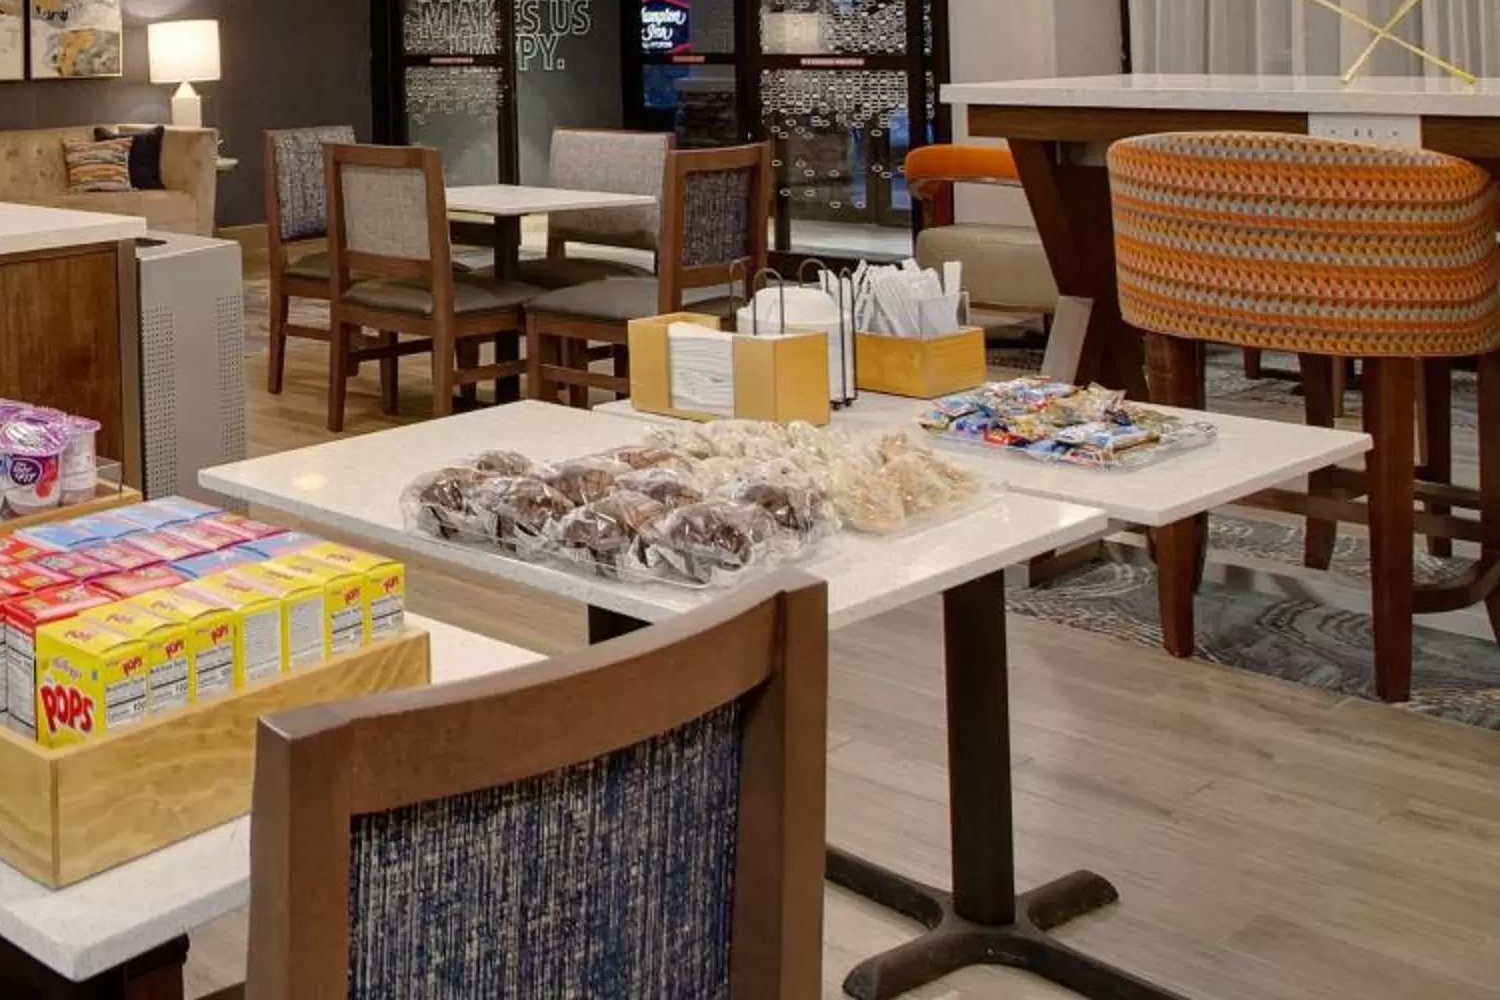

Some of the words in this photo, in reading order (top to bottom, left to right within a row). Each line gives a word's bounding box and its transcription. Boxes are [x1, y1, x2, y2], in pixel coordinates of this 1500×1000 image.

[548, 0, 592, 36] US
[449, 33, 566, 72] HAPY.
[210, 624, 229, 645] POPS
[165, 639, 186, 660] POPS
[122, 655, 143, 676] POPS
[40, 684, 95, 734] POPS
